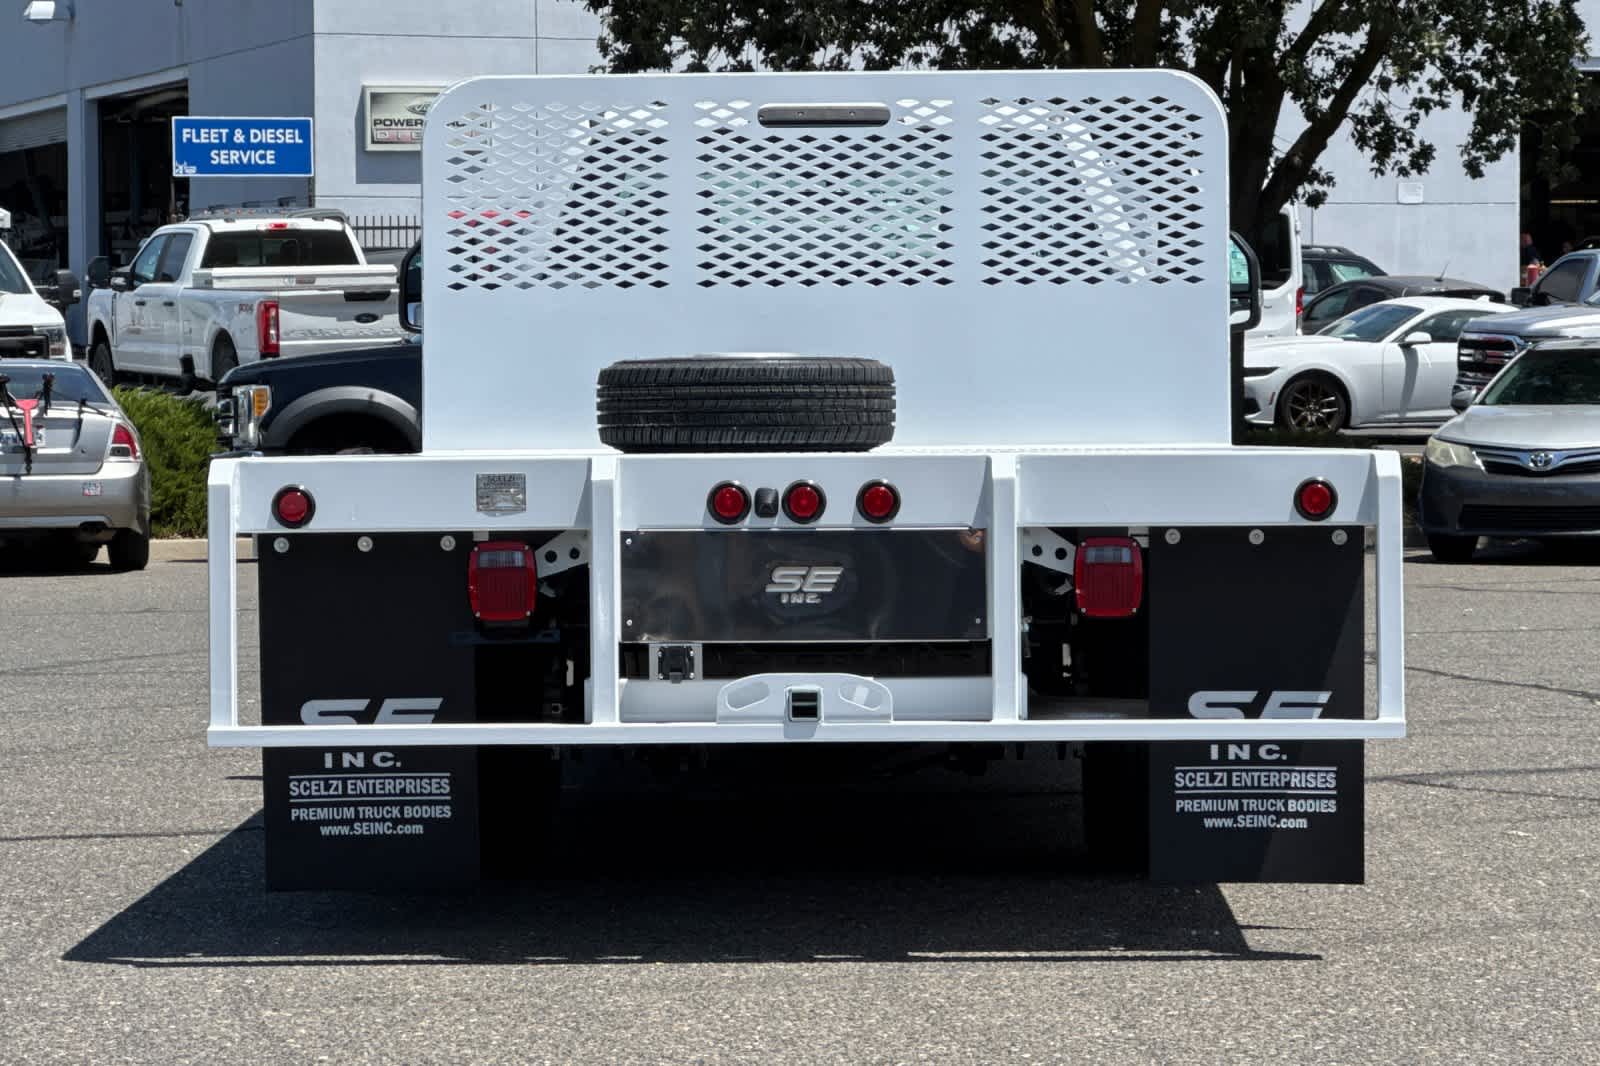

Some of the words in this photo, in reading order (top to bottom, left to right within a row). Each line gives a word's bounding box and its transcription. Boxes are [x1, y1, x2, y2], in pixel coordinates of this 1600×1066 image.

[374, 119, 424, 127] POWER
[182, 128, 229, 143] FLEET
[233, 128, 245, 143] &
[250, 128, 303, 143] DIESEL
[210, 150, 276, 164] SERVICE
[765, 566, 844, 592] SE
[324, 751, 402, 768] INC.
[1210, 744, 1288, 760] INC.
[289, 780, 342, 796] SCELZI
[347, 778, 450, 795] ENTERPRISES
[1175, 772, 1227, 787] SCELZI
[1232, 772, 1337, 788] ENTERPRISES
[291, 807, 355, 820] PREMIUM
[358, 806, 400, 819] TRUCK
[403, 805, 451, 818] BODIES
[1175, 799, 1239, 812] PREMIUM
[1241, 799, 1285, 812] TRUCK
[1288, 799, 1337, 813] BODIES
[320, 822, 424, 836] www.SEINC.com
[1204, 815, 1308, 828] www.SEINC.com
